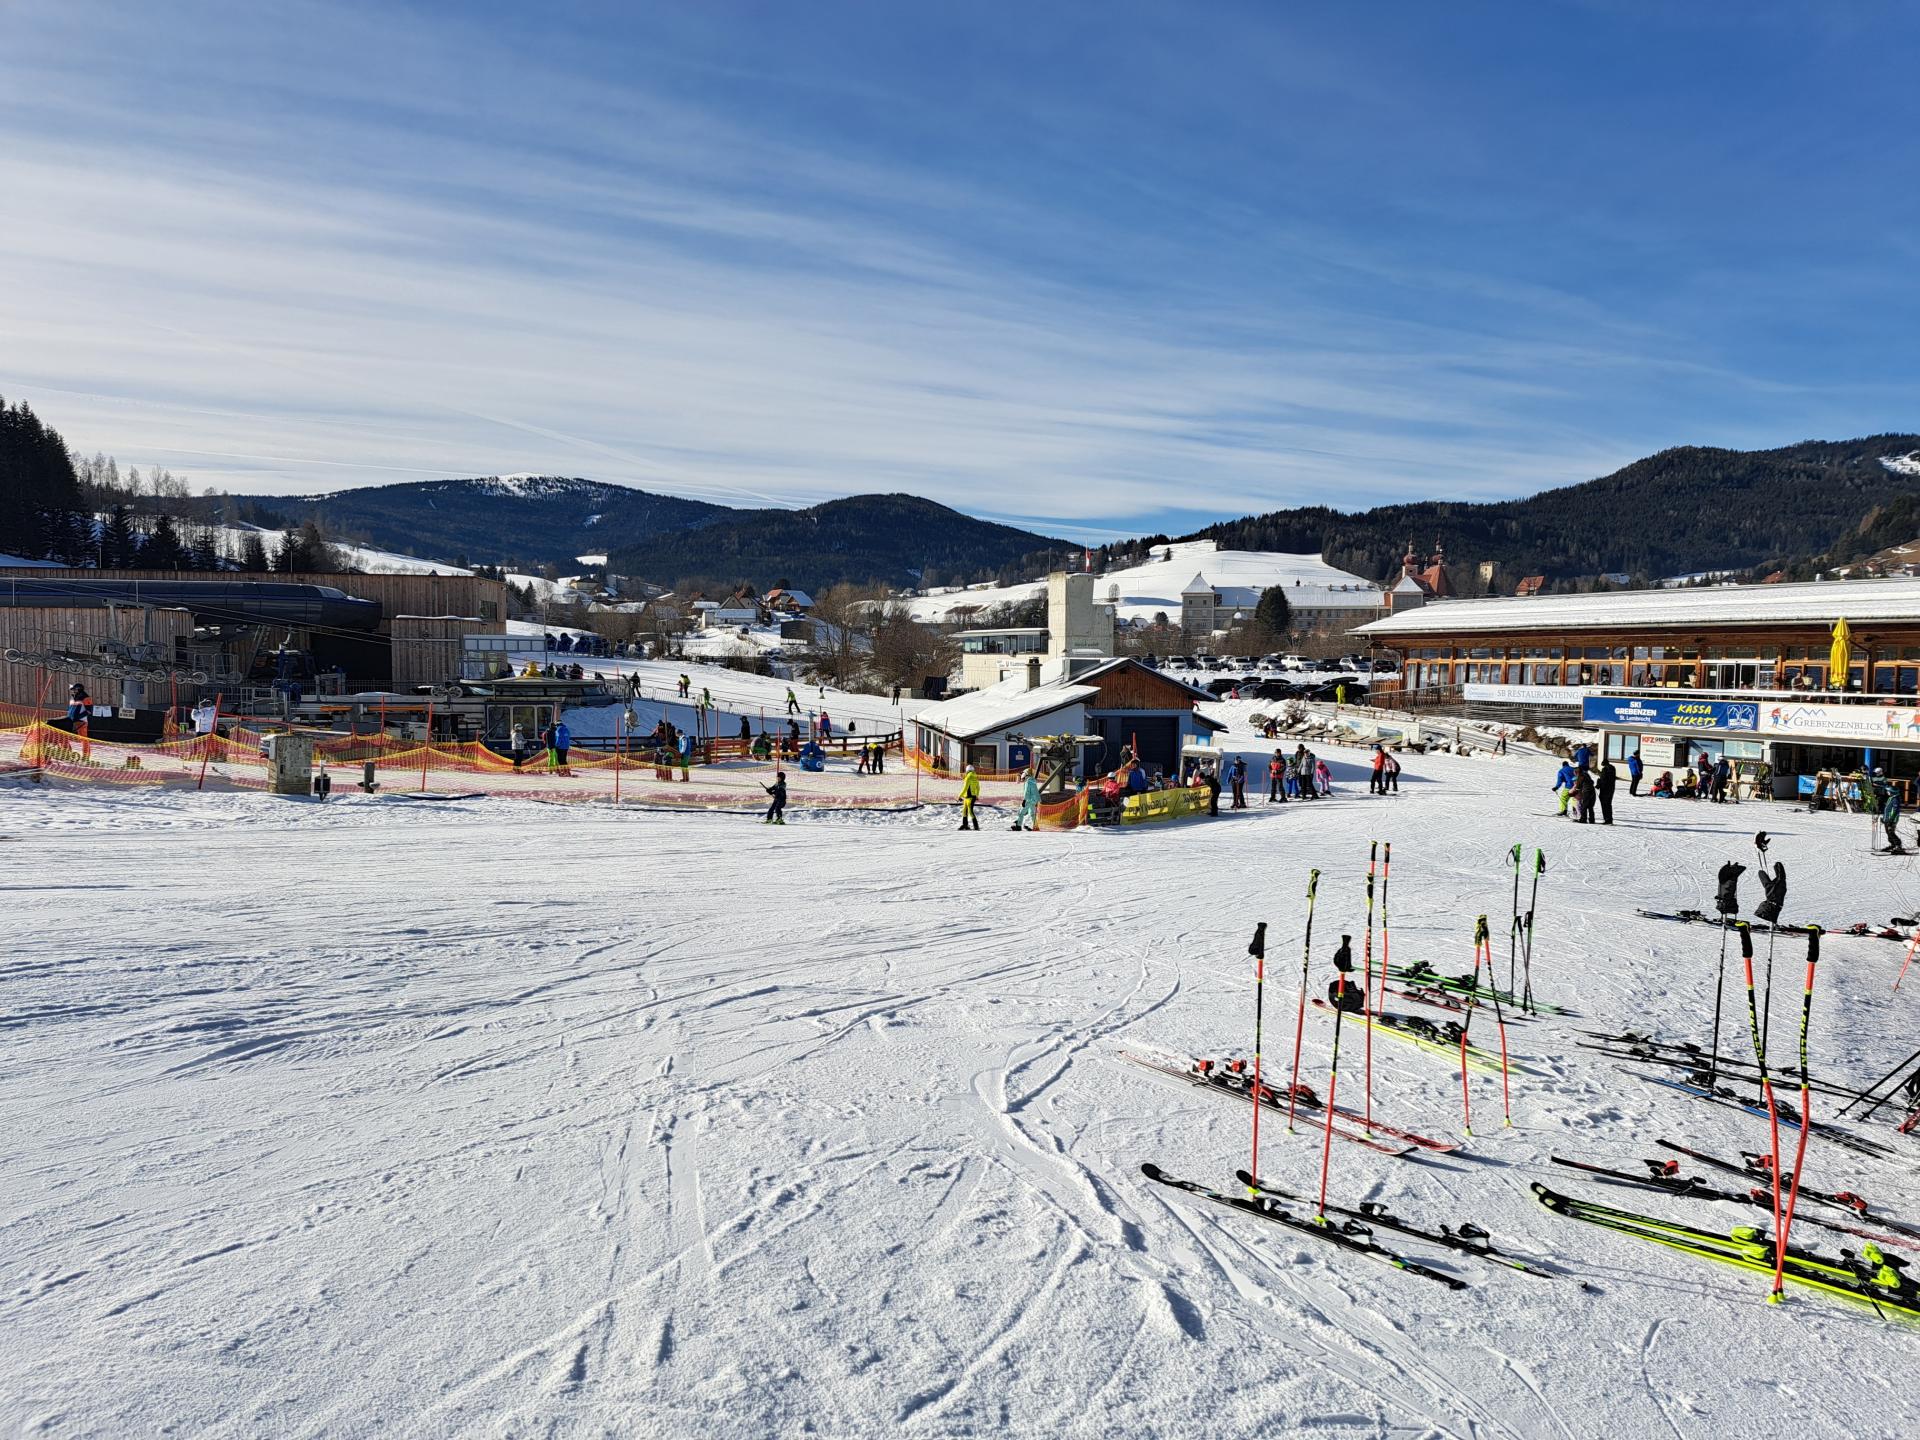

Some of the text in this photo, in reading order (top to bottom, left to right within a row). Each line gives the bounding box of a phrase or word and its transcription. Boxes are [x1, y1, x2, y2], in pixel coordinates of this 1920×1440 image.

[1614, 707, 1657, 716] GREBENZEN
[1677, 704, 1712, 715] KASSA
[1672, 715, 1717, 726] TICKETS
[1794, 717, 1884, 731] GREBENZENBLICK
